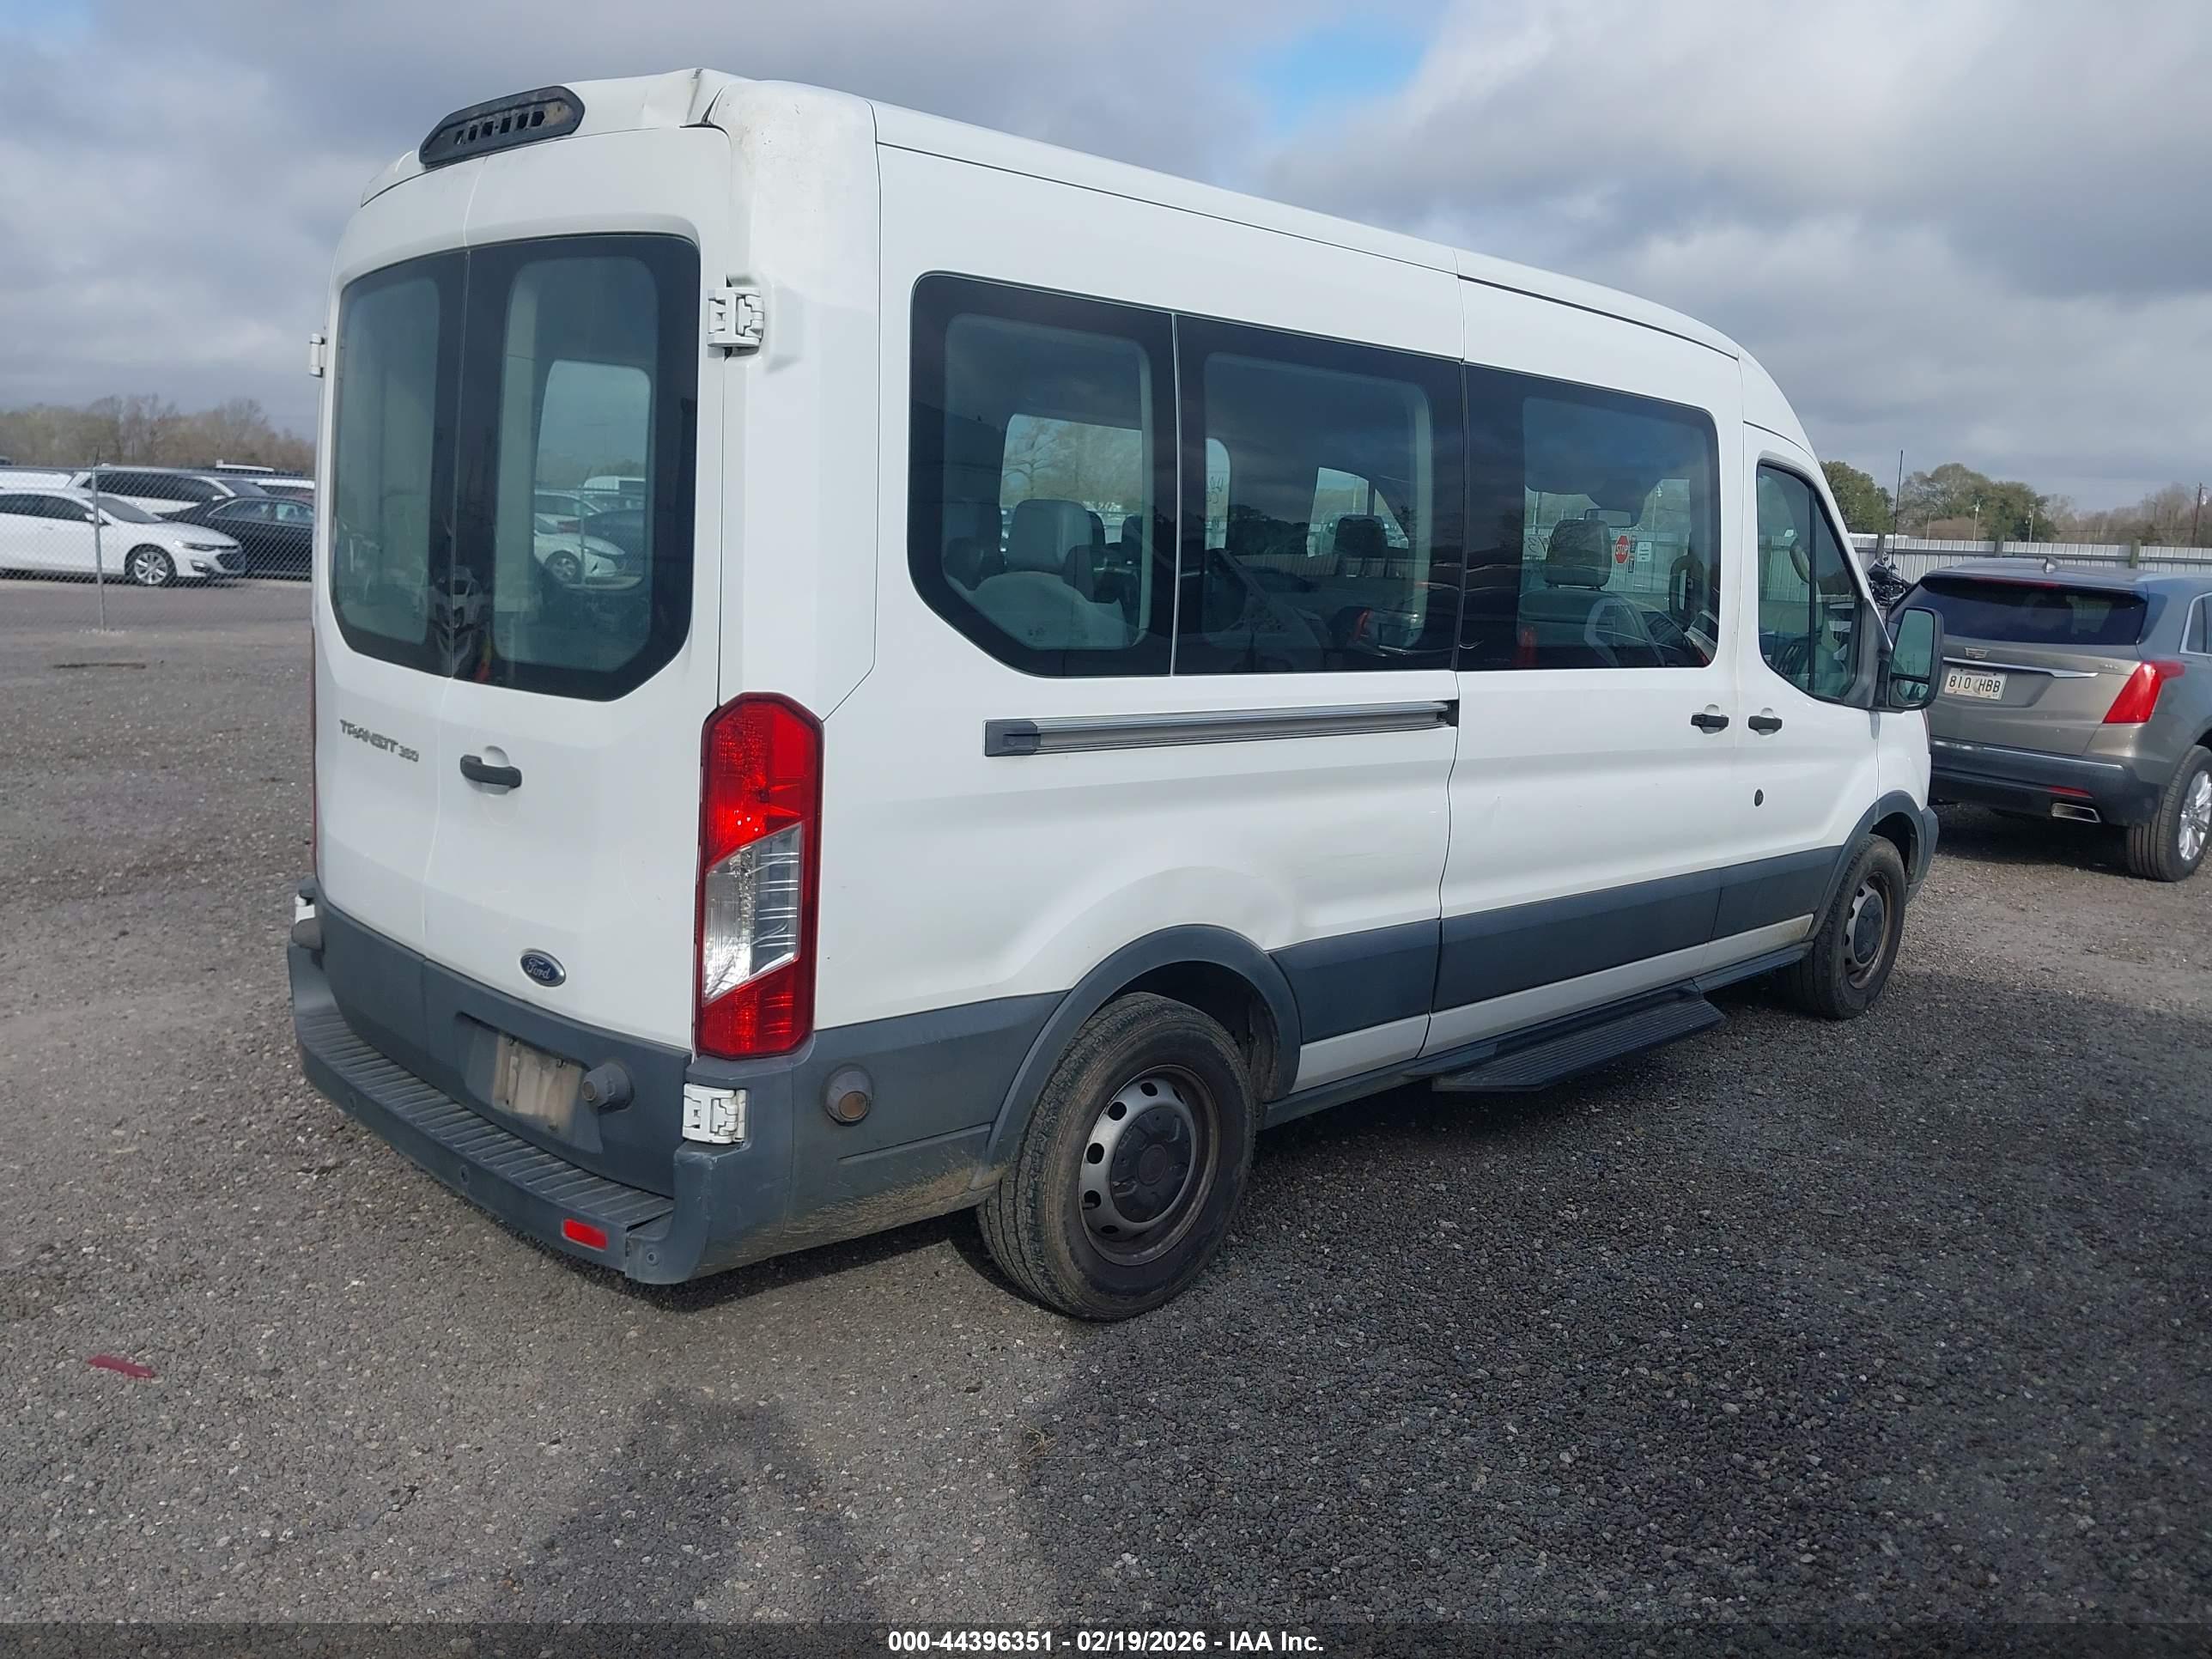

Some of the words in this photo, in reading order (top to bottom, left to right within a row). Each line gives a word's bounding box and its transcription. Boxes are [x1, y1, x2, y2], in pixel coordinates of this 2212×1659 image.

[1615, 544, 1629, 556] STOP
[1949, 676, 1972, 689] 810
[1978, 678, 2001, 693] HBB
[339, 719, 398, 753] TRANSIT
[398, 745, 419, 763] 350
